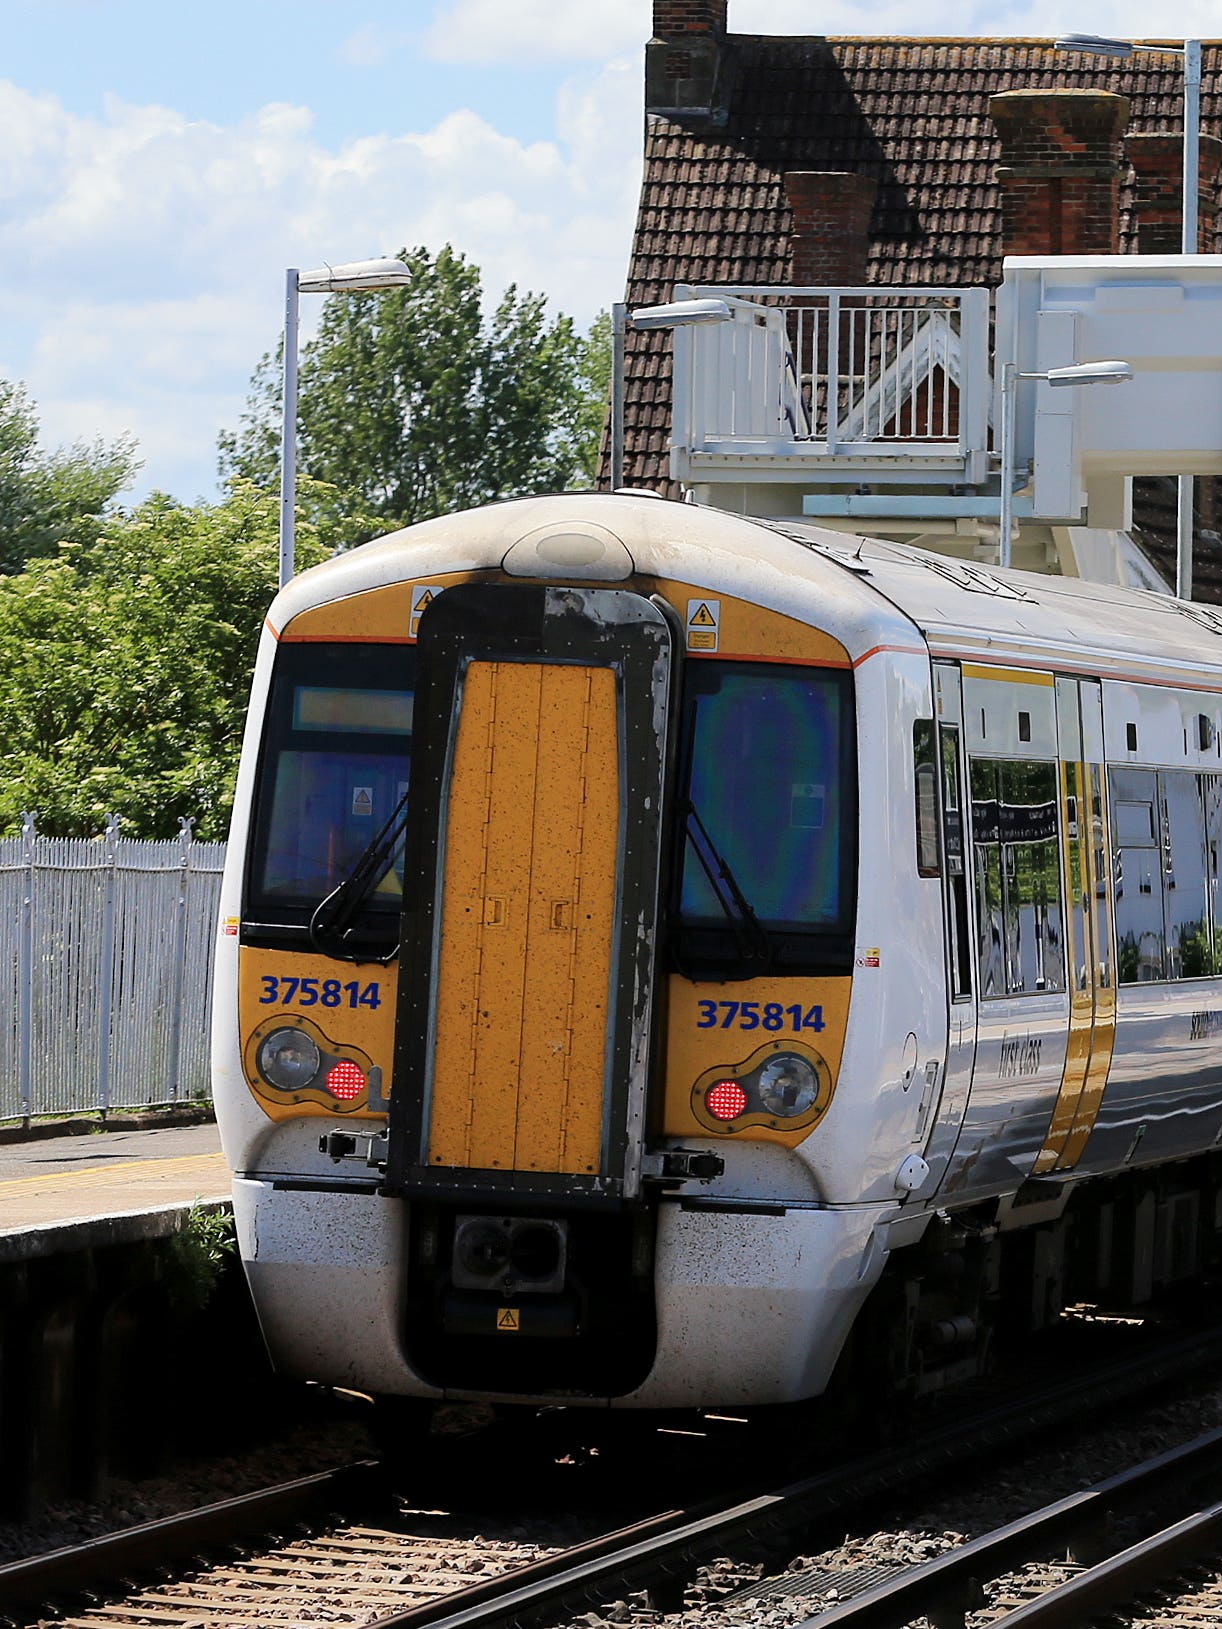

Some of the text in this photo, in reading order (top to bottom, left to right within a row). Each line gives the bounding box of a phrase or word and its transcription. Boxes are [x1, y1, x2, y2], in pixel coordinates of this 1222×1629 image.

[258, 975, 382, 1010] 375814
[697, 999, 826, 1033] 375814
[998, 1028, 1042, 1078] first class
